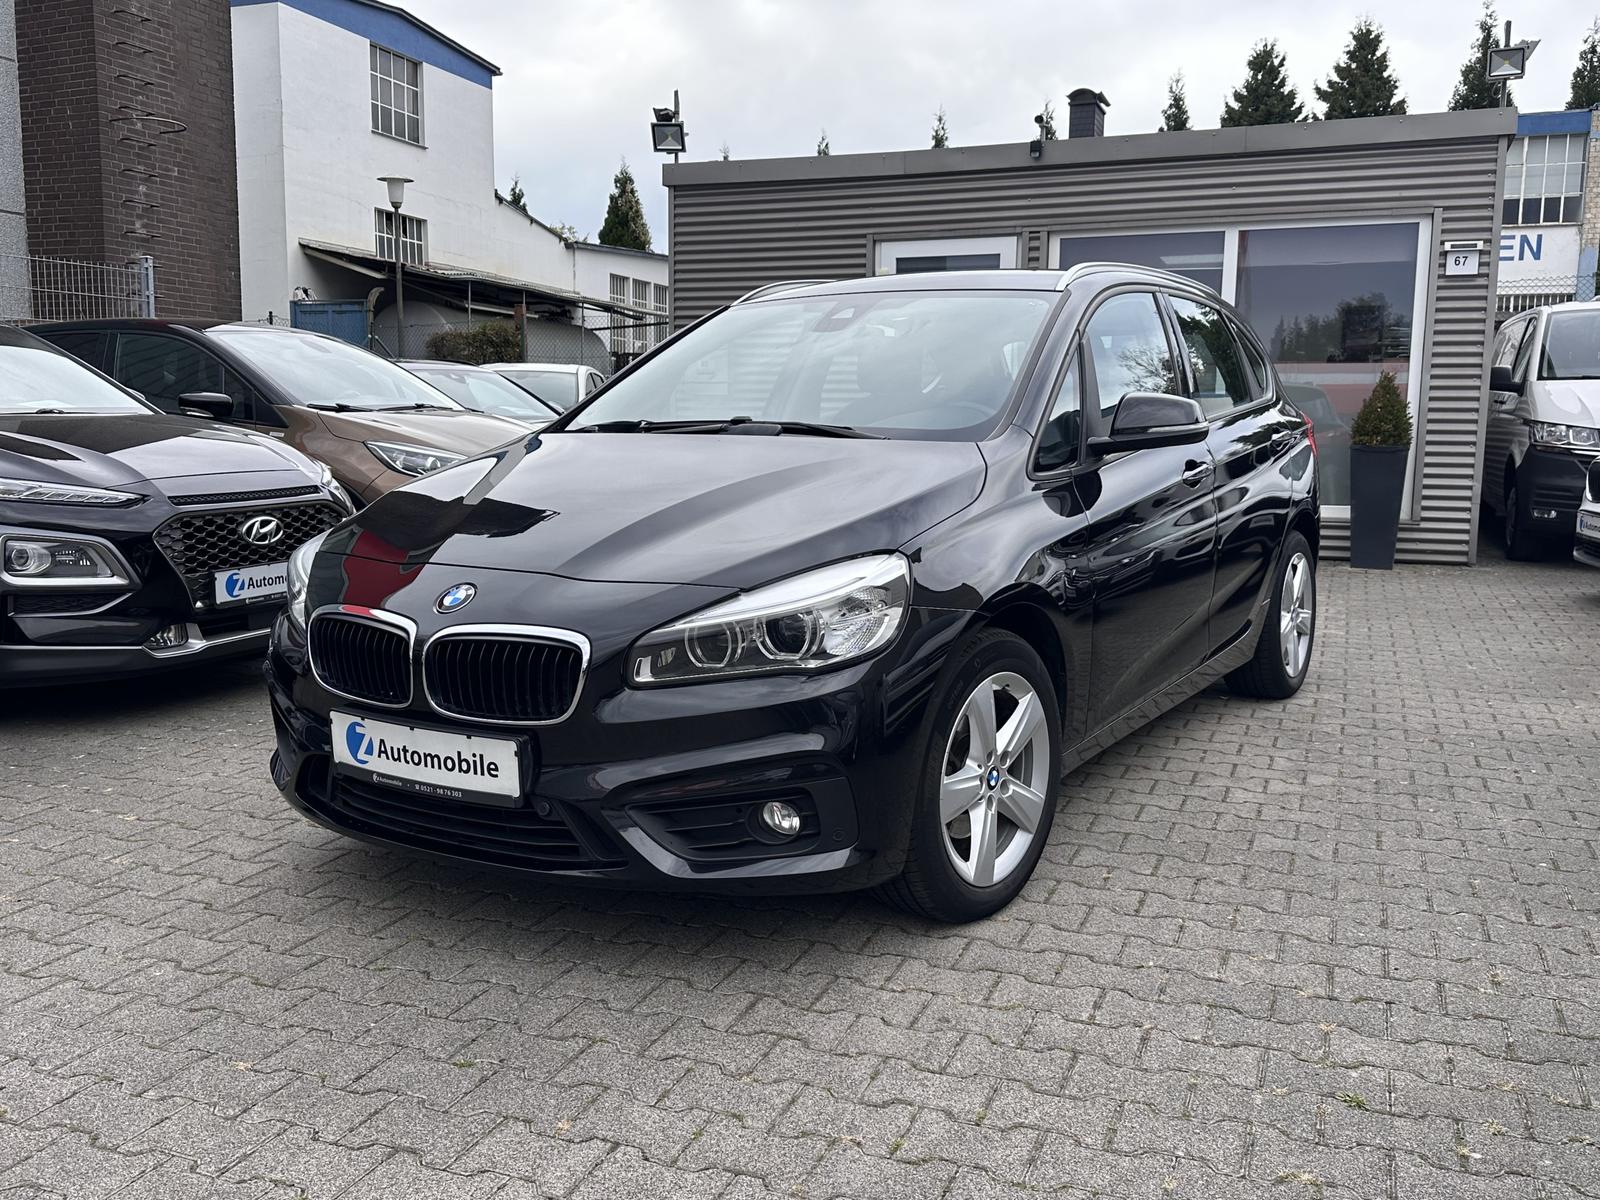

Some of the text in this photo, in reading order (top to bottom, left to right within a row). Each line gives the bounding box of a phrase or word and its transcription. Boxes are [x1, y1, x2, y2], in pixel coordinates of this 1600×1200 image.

[1454, 256, 1468, 266] 67
[247, 575, 287, 590] Autom
[377, 738, 500, 778] Automobile
